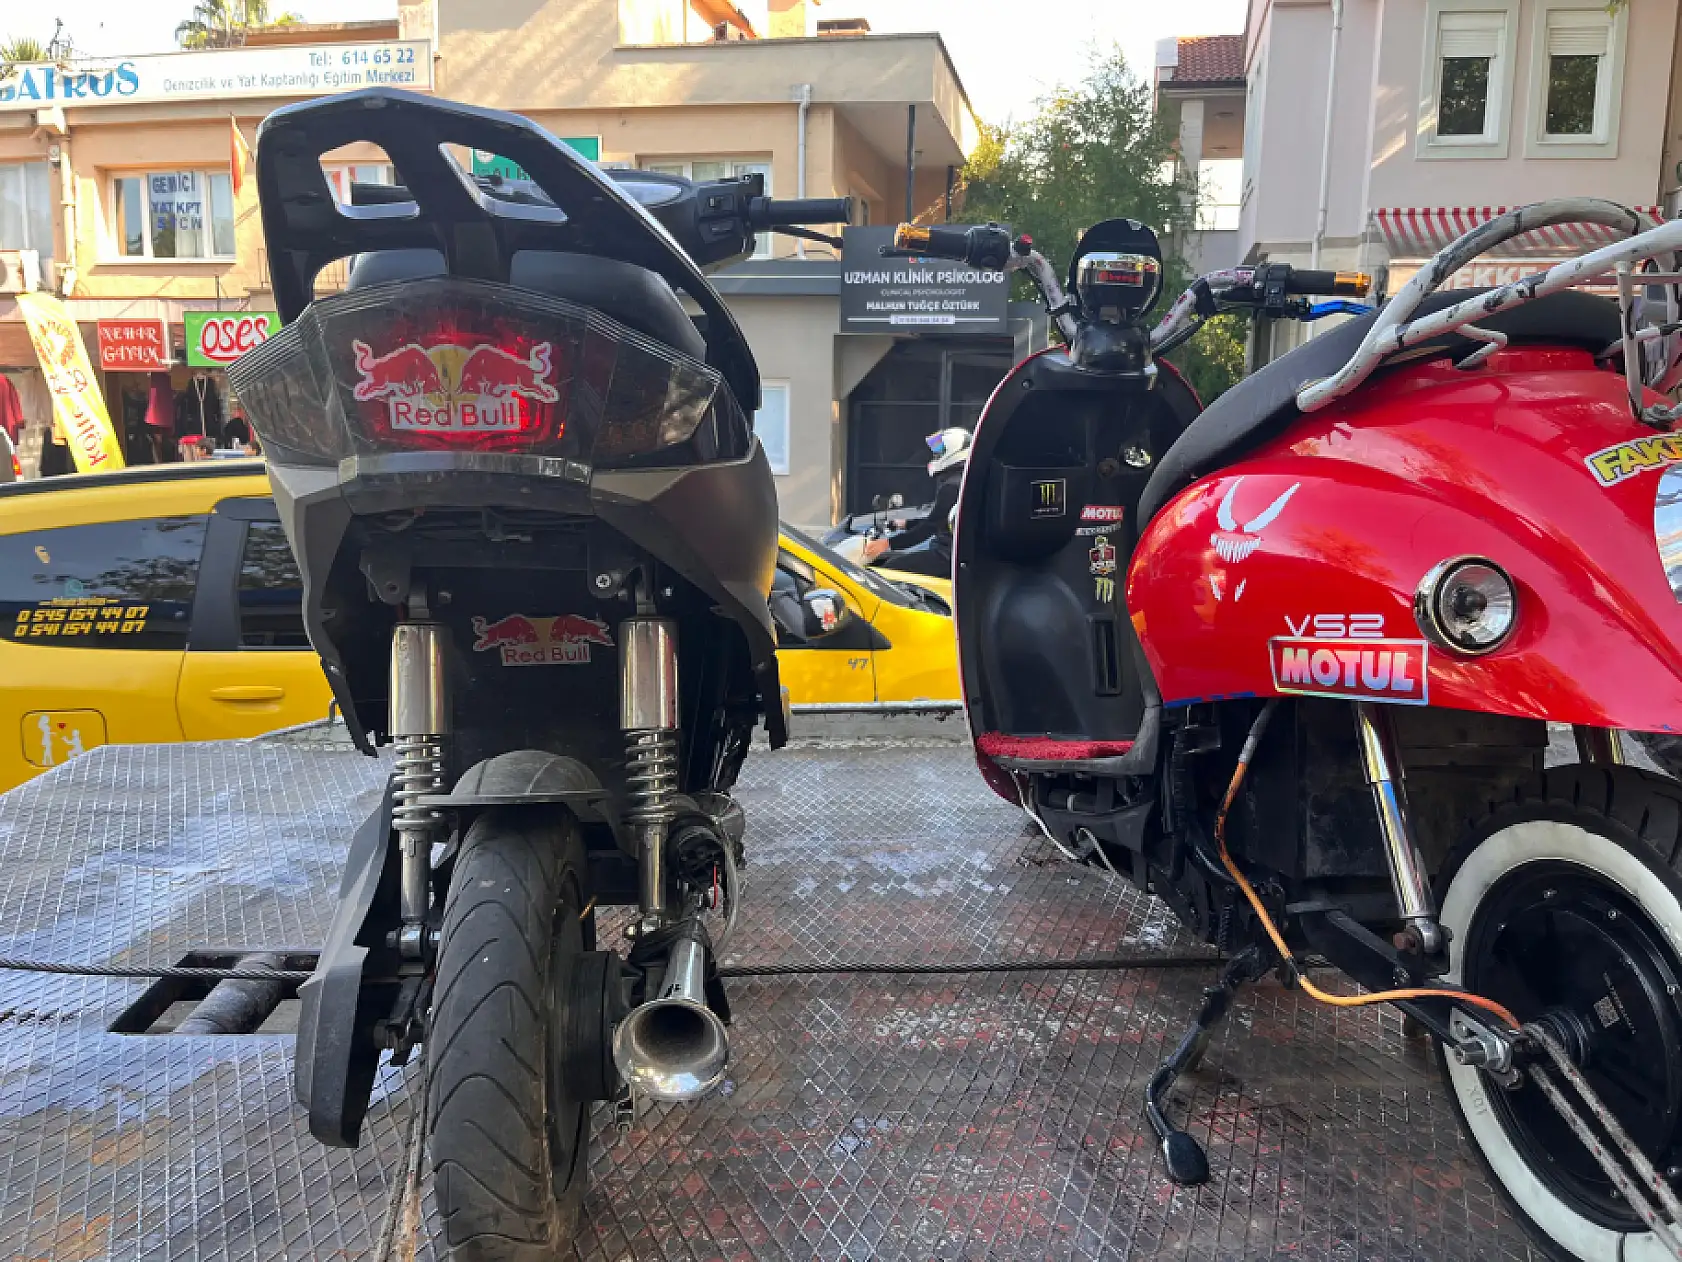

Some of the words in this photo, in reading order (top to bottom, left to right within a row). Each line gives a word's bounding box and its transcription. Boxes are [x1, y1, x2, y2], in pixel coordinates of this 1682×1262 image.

[309, 52, 332, 66] Tel:
[342, 51, 368, 64] 614
[373, 49, 391, 63] 65
[396, 48, 415, 62] 22
[163, 77, 216, 92] Denizcilik
[220, 76, 233, 88] ve
[238, 75, 256, 88] Yat
[323, 70, 361, 87] Eğitim
[365, 68, 415, 82] Merkezi
[844, 272, 890, 284] UZMAN
[893, 268, 934, 284] KLİNİK
[936, 268, 1004, 284] PSİKOLOG
[394, 402, 450, 426] Red
[460, 402, 516, 426] Bull
[1082, 507, 1123, 520] MOTU
[17, 610, 31, 622] 0
[32, 609, 68, 621] 545
[100, 606, 124, 619] 44
[124, 605, 150, 619] 07
[14, 624, 28, 637] 0
[95, 621, 119, 634] 44
[120, 619, 146, 633] 07
[505, 648, 545, 663] Red
[551, 645, 588, 661] Bull
[1281, 647, 1414, 691] MOTUL
